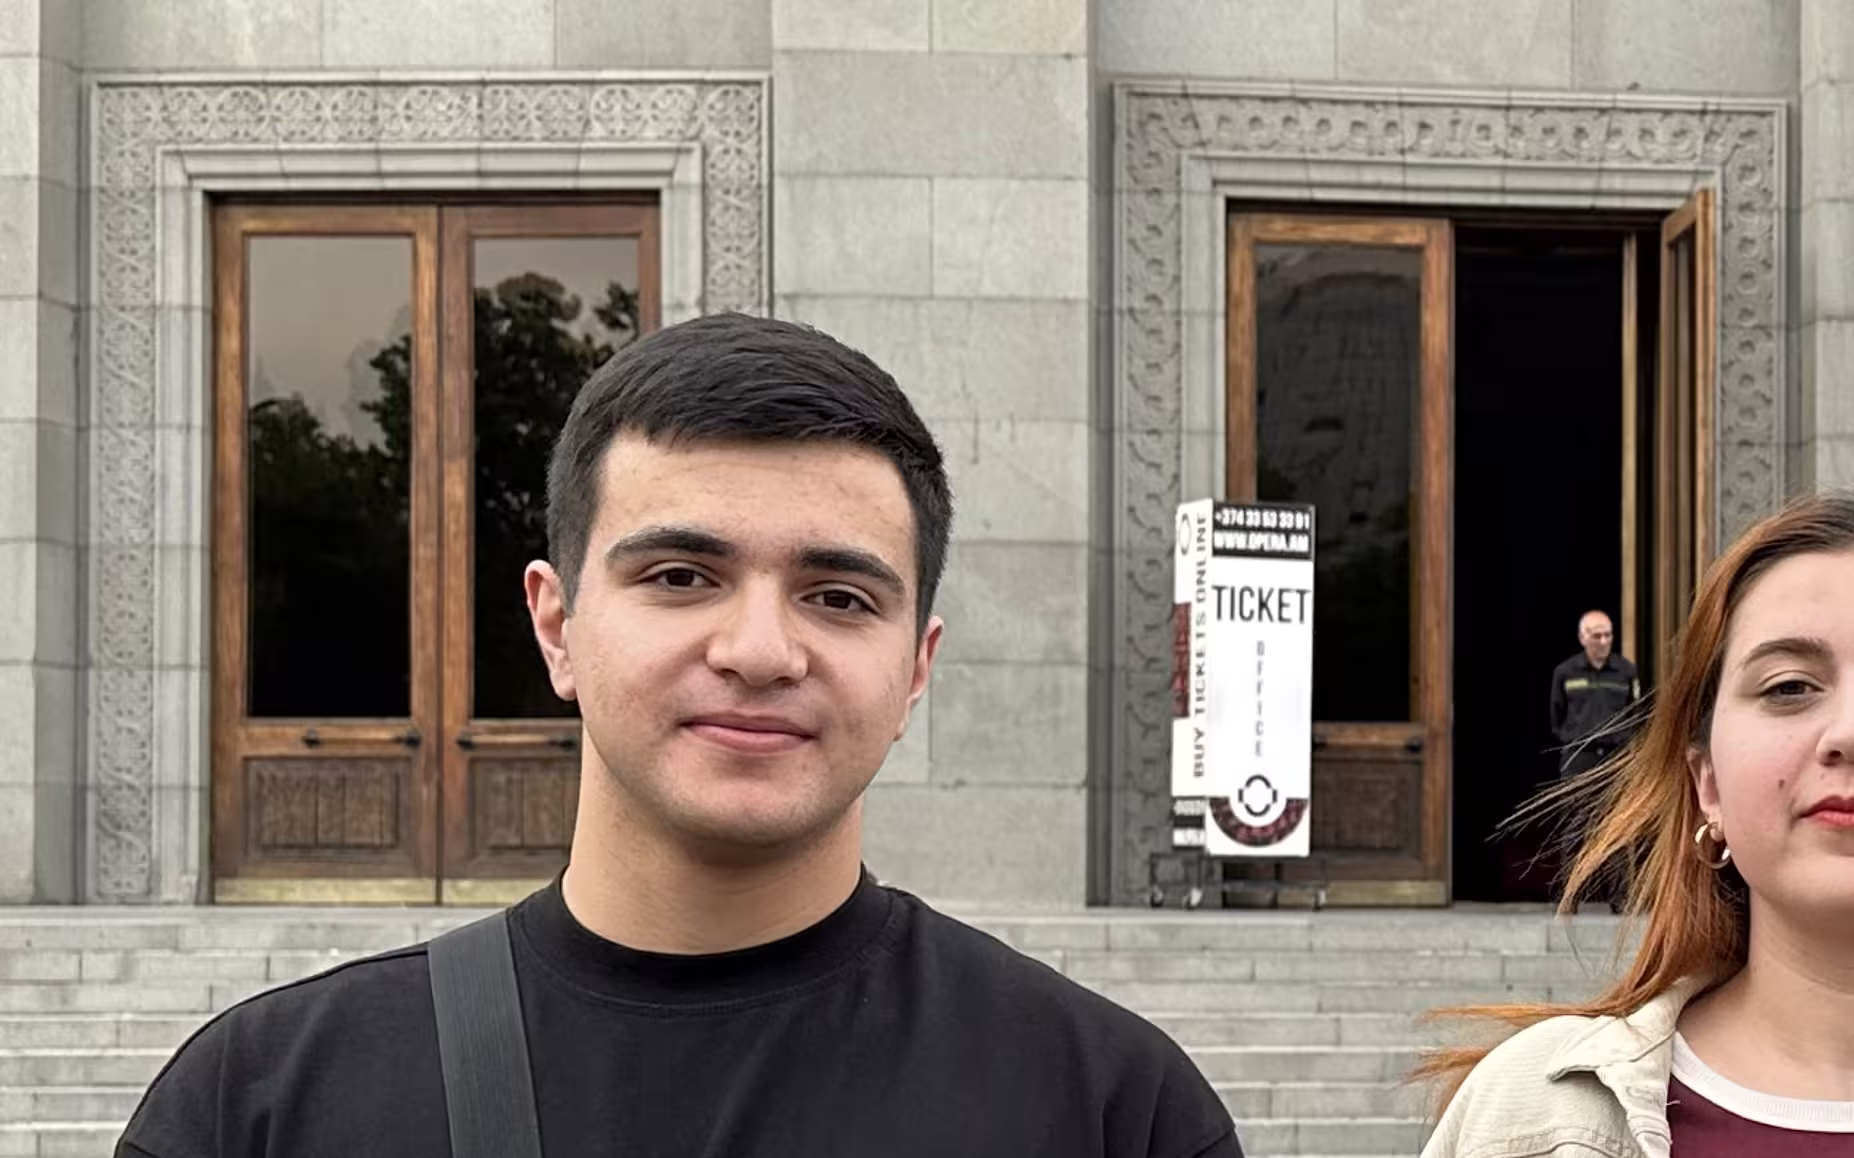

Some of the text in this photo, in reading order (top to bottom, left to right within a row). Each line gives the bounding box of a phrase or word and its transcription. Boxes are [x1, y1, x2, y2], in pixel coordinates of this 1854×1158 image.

[1193, 512, 1207, 778] BUY TICKETS ONLINE
[1211, 584, 1312, 624] TICKET
